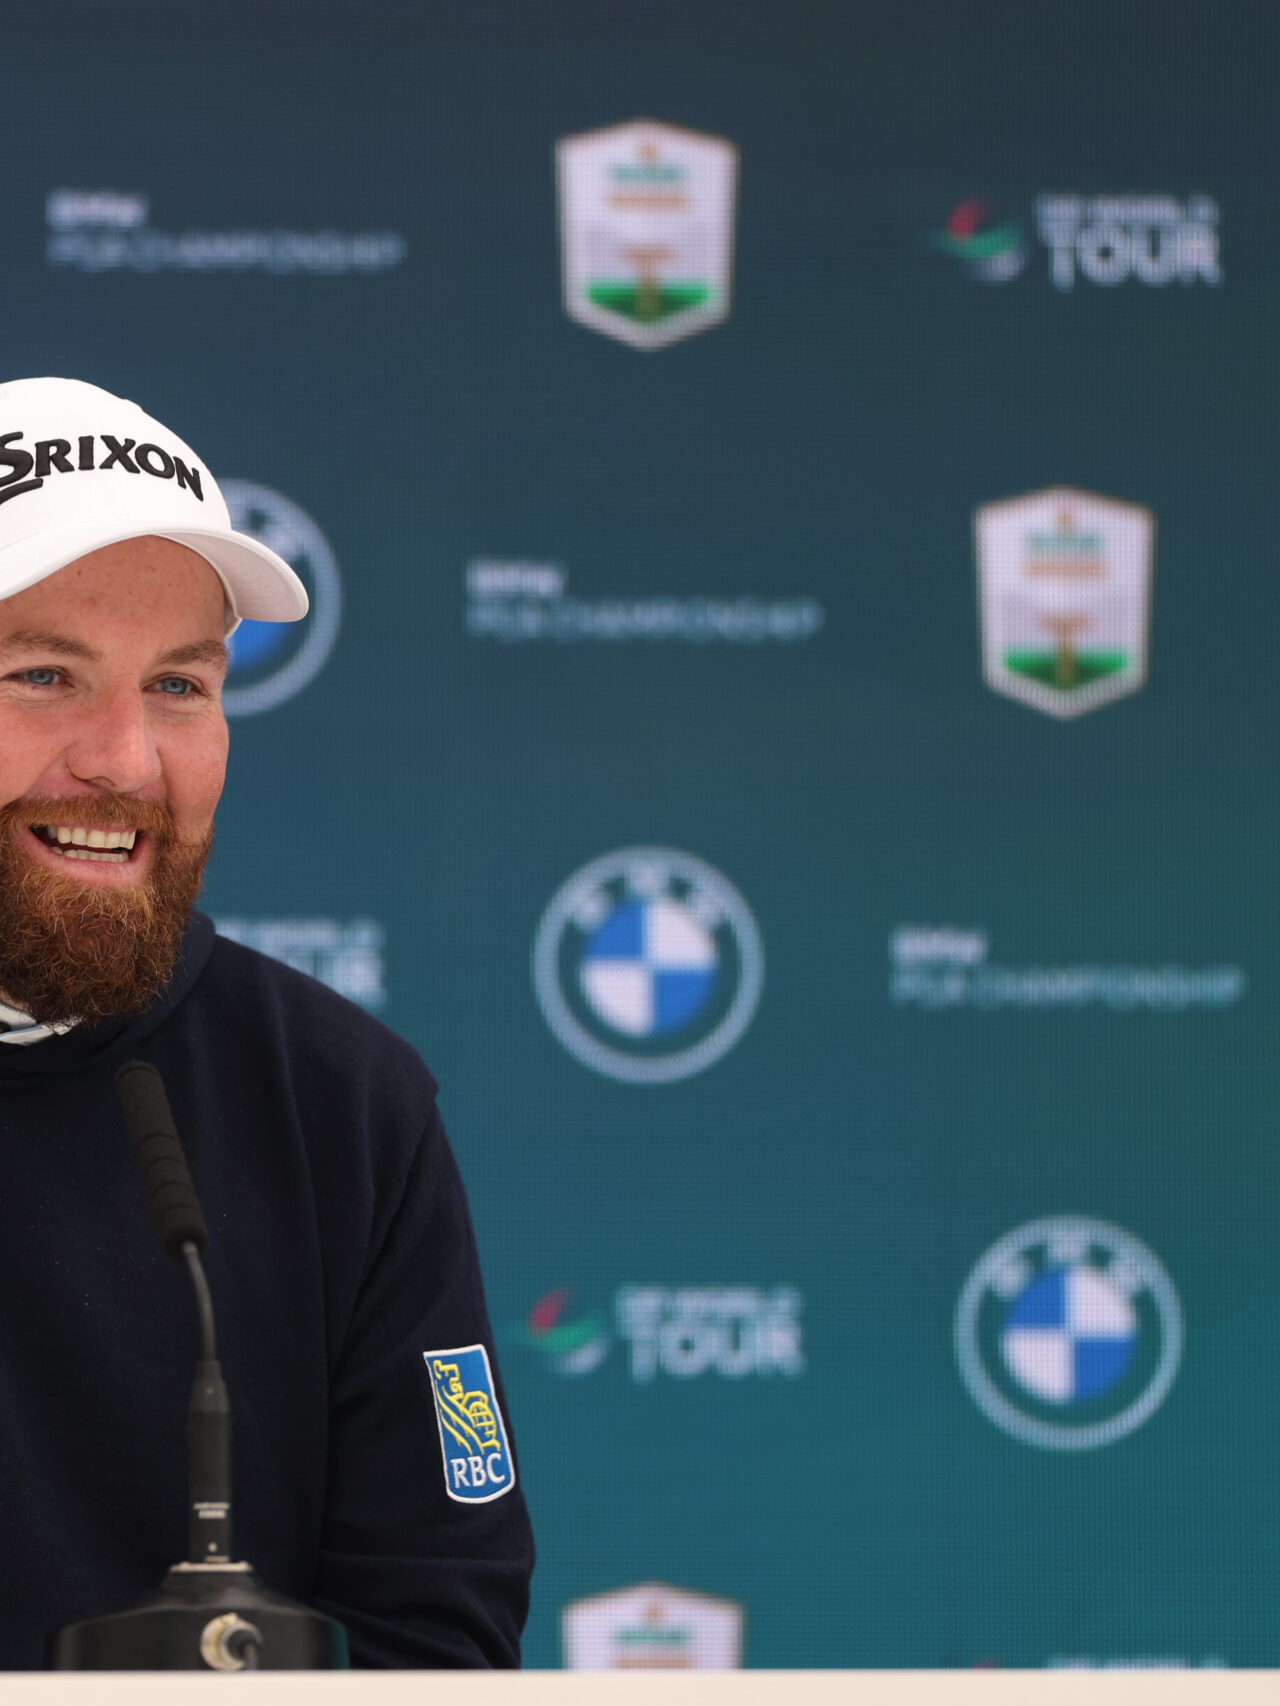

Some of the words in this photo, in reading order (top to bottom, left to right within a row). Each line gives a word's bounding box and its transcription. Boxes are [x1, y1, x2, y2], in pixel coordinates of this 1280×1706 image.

[1040, 221, 1221, 290] TOUR
[620, 1313, 803, 1381] TOUR
[450, 1452, 506, 1489] RBC
